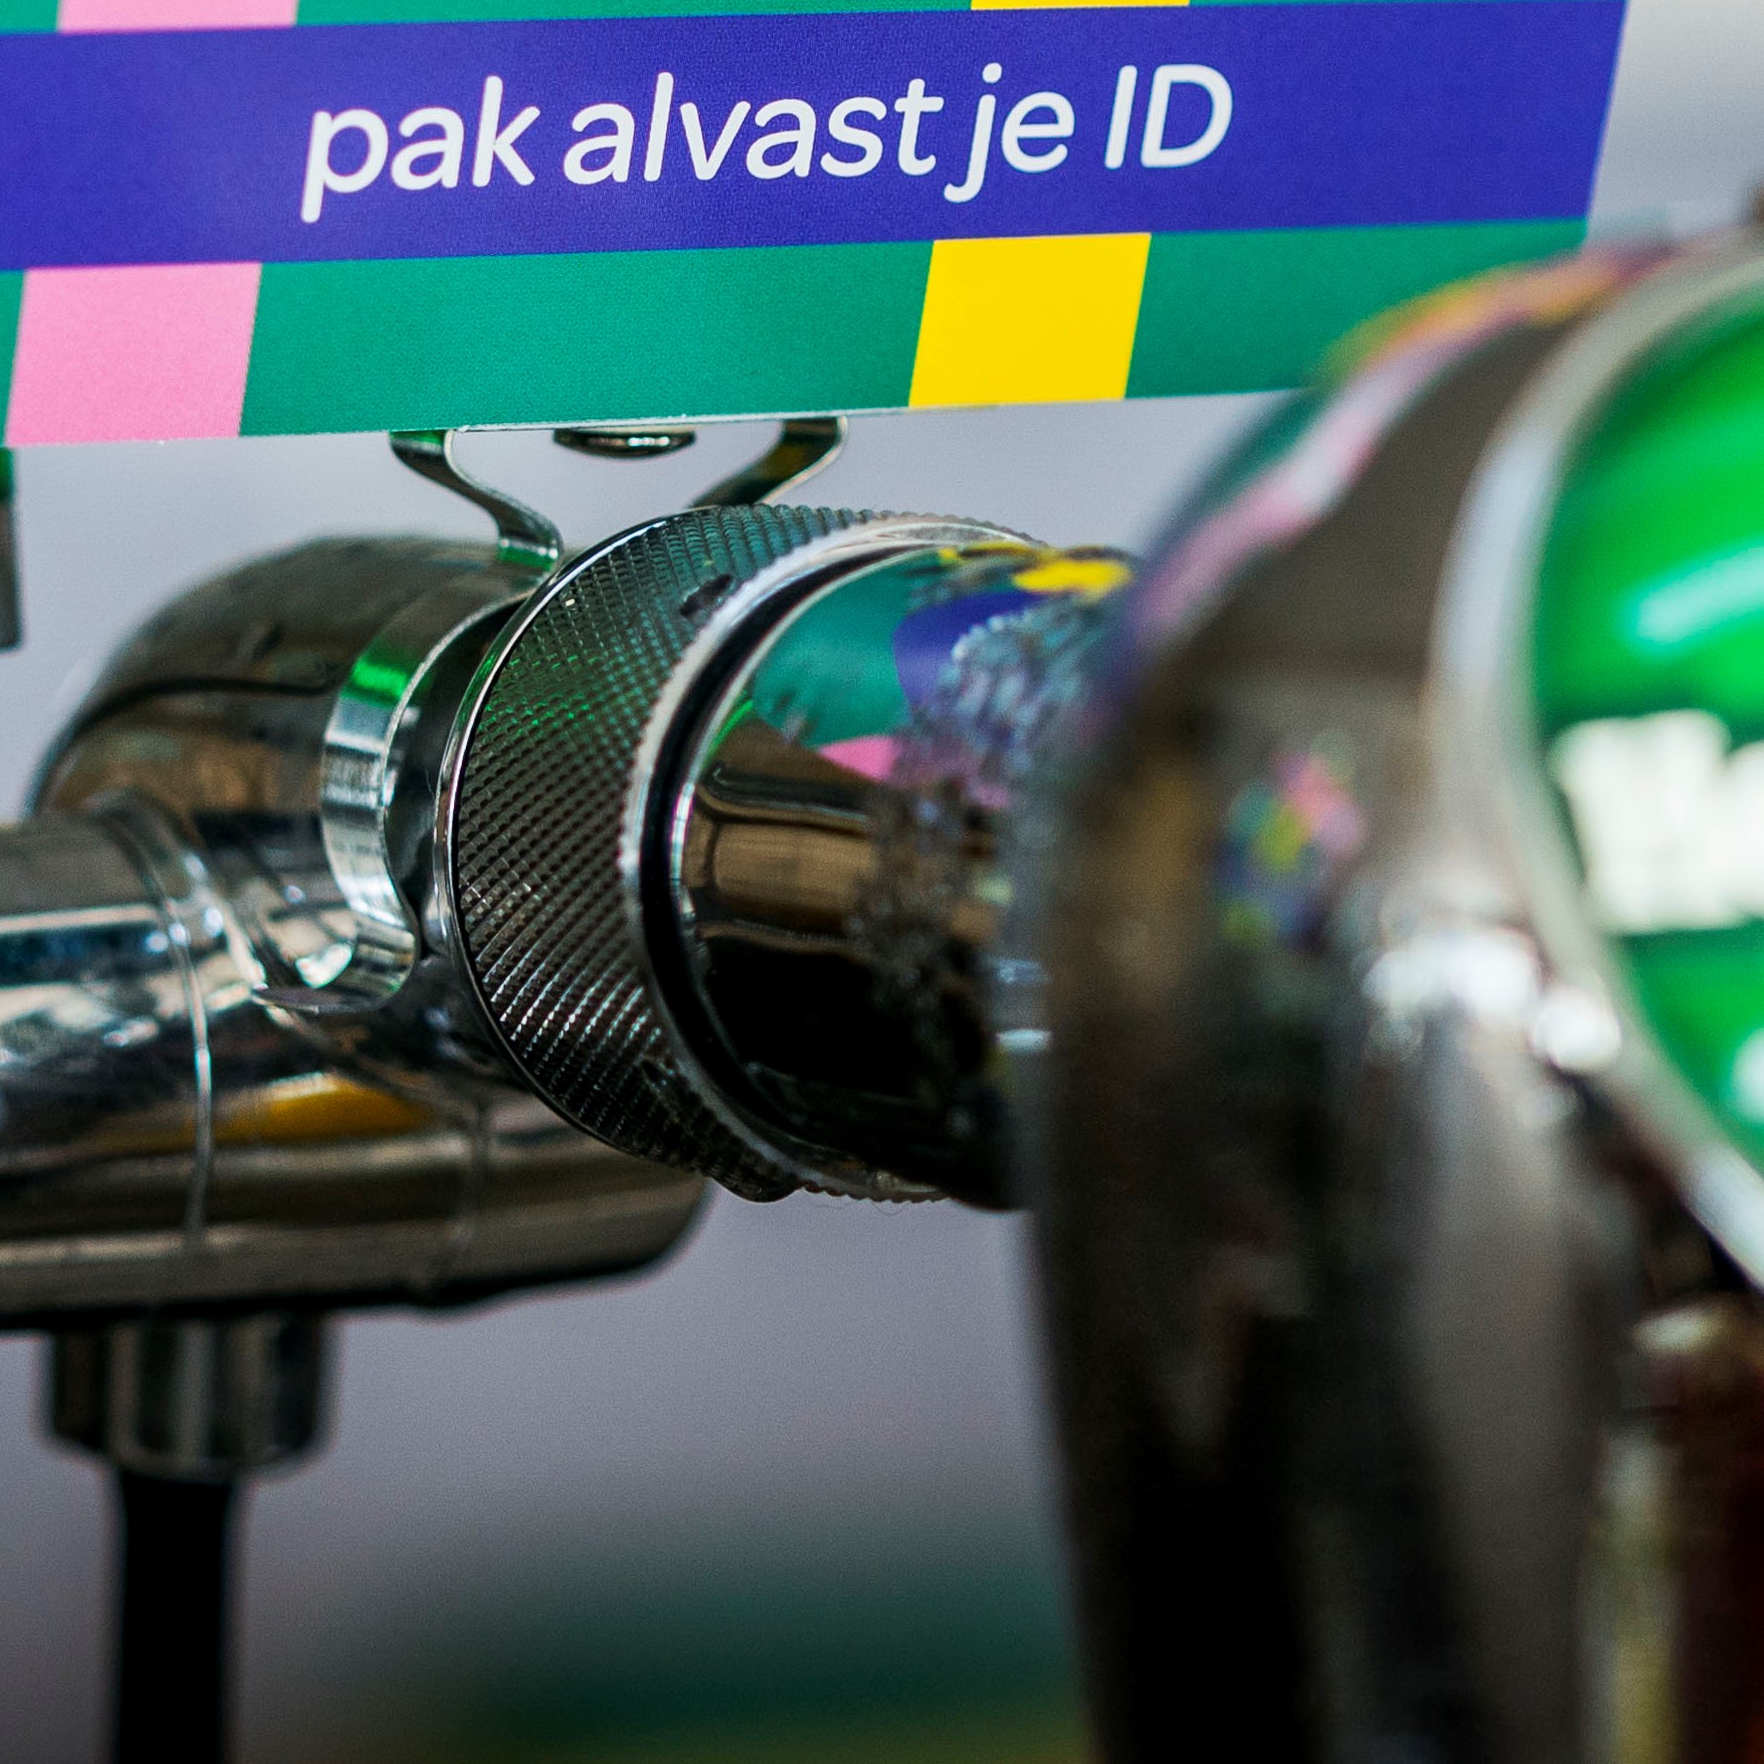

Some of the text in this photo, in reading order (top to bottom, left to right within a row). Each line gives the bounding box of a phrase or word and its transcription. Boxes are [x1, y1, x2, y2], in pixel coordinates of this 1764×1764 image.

[299, 62, 1234, 225] pak alvast je ID
